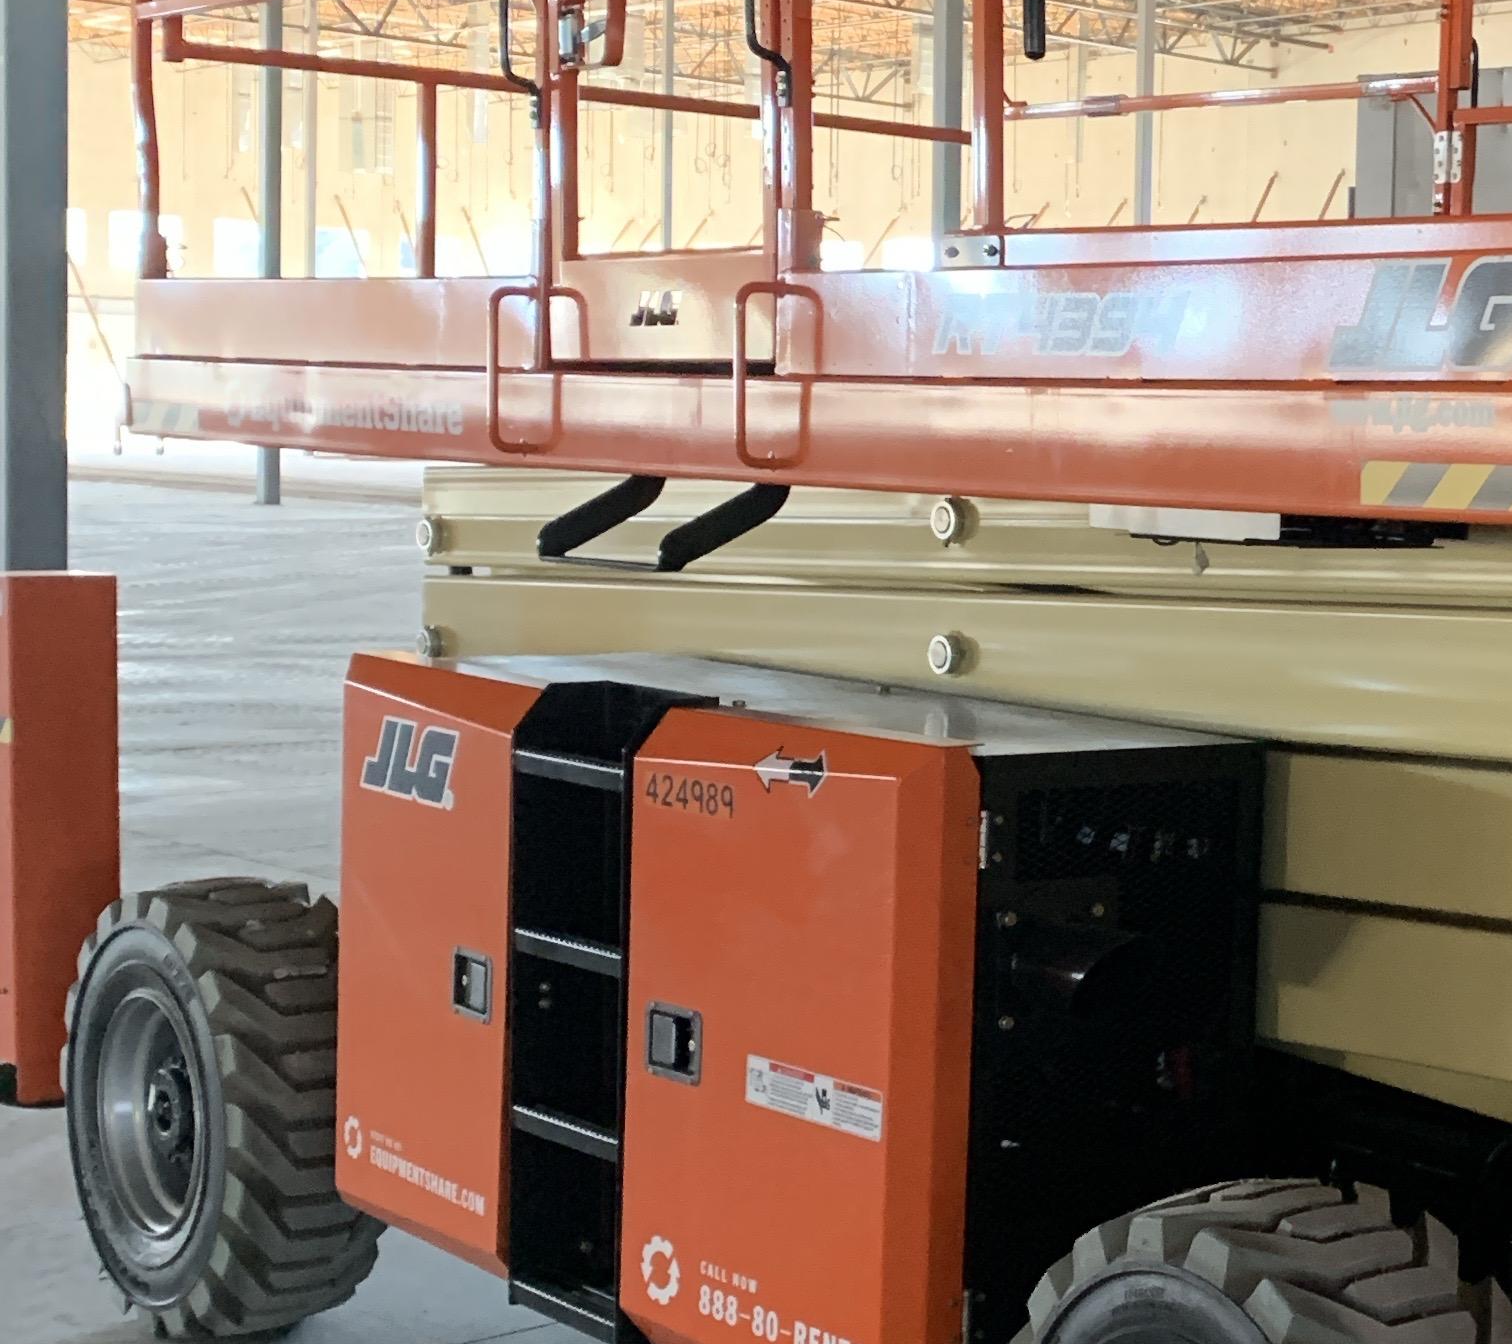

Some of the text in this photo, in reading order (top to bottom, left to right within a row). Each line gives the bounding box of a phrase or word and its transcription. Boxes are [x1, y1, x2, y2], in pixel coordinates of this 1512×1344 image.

[360, 716, 460, 810] JLG
[645, 773, 734, 819] 424989
[369, 1145, 486, 1217] EQUIPMENTSHARE.COM
[700, 1260, 758, 1293] CALL NOW
